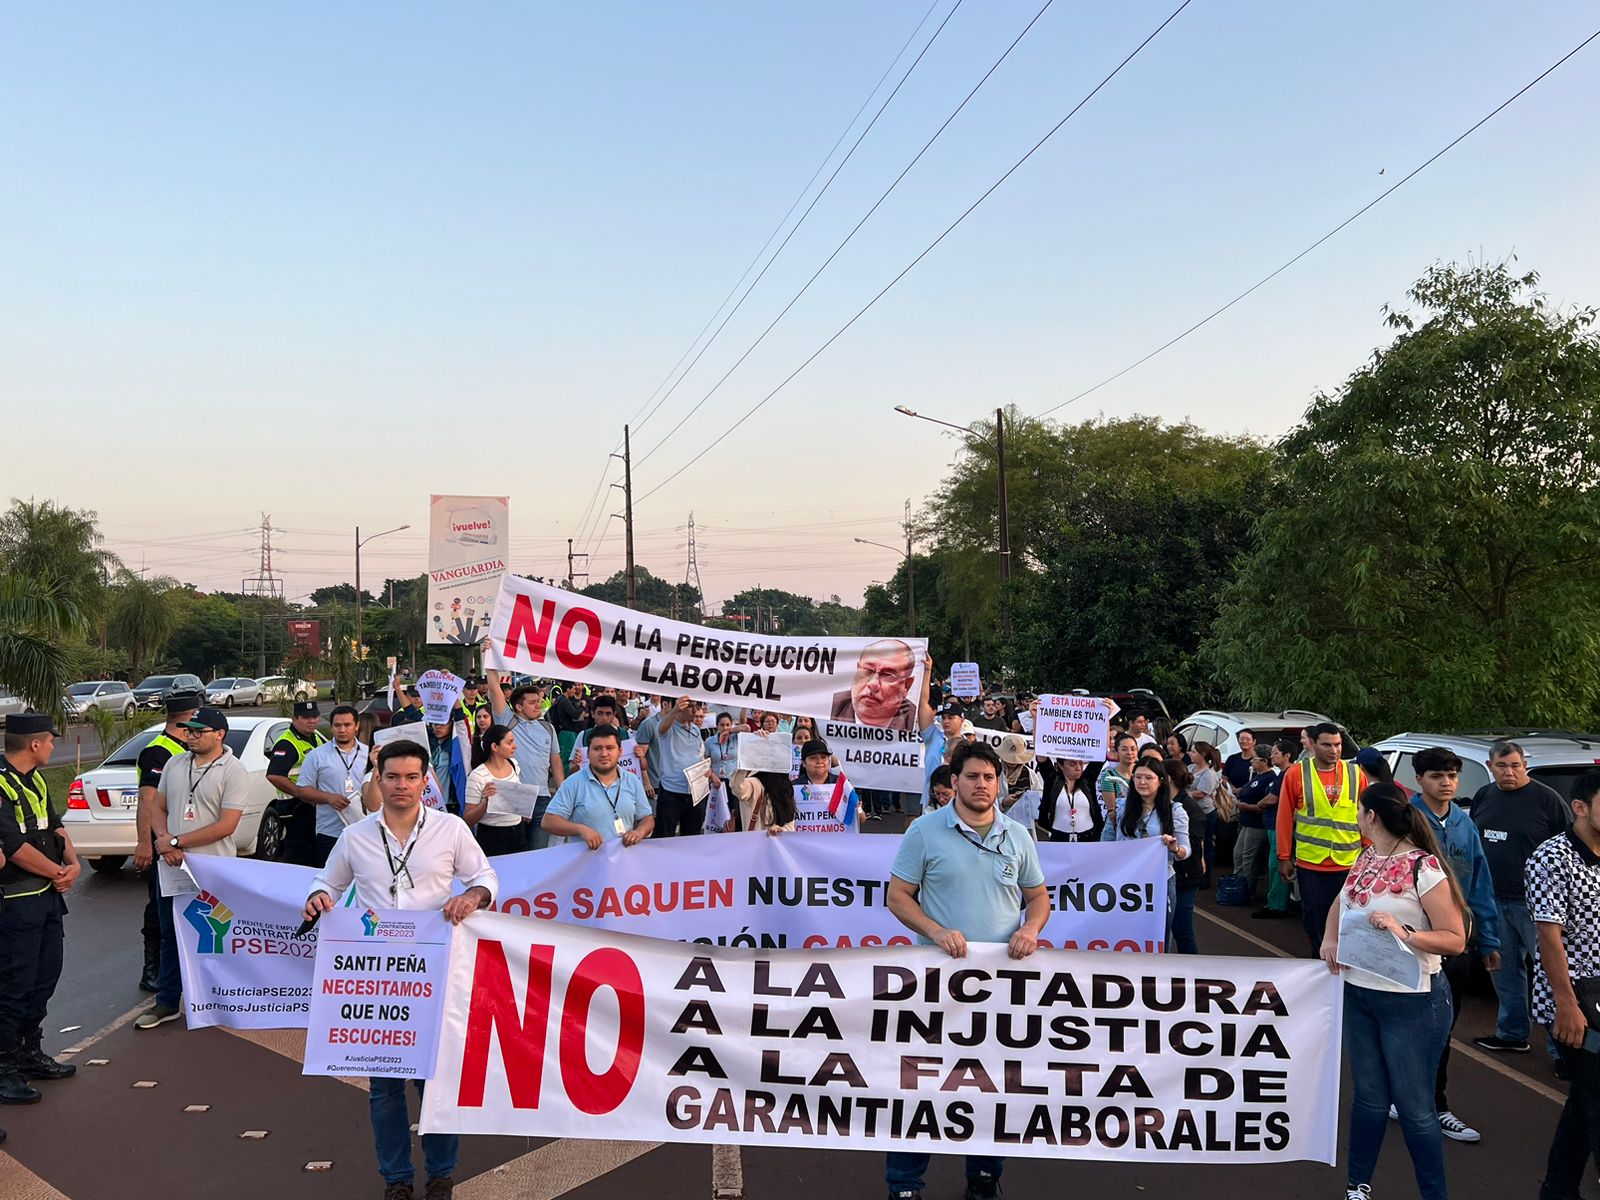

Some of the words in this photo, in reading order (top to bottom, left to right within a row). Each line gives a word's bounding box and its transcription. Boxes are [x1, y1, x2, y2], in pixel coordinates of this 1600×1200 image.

[431, 559, 505, 583] VANGUARDIA
[503, 593, 602, 670] NO
[611, 620, 626, 647] A
[634, 624, 662, 652] LA
[676, 633, 837, 675] PERSECUCIÓN
[641, 658, 782, 701] LABORAL
[1051, 697, 1069, 706] ESTA
[1071, 698, 1095, 708] LUCHA
[1040, 707, 1073, 718] TAMBIEN
[1073, 710, 1082, 719] ES
[1085, 711, 1105, 722] TUYA,
[826, 723, 894, 742] EXIGIMOS
[898, 729, 925, 743] RES
[1054, 721, 1089, 734] FUTURO
[1042, 734, 1100, 748] CONCURSANTE!!
[122, 796, 138, 804] AAF
[795, 811, 814, 821] ANTI
[796, 823, 845, 832] CESITAMOS
[488, 891, 559, 920] OS
[571, 878, 734, 919] SAQUEN
[748, 877, 889, 907] NUEST
[1046, 877, 1154, 913] EÑOS!
[237, 919, 262, 928] FRENTE
[232, 926, 318, 943] CONTRATADO
[377, 929, 415, 937] PSE2023
[333, 955, 381, 971] SANTI
[386, 954, 427, 973] PEÑA
[322, 979, 432, 998] NECESITAMOS
[673, 956, 726, 993] A
[753, 960, 846, 999] LA
[872, 964, 1290, 1017] DICTADURA
[341, 1004, 374, 1020] QUE
[378, 1005, 410, 1021] NOS
[457, 938, 646, 1115] NO
[670, 999, 723, 1035] A
[750, 1003, 844, 1040] LA
[870, 1008, 1291, 1060] INJUSTICIA
[328, 1028, 417, 1046] ESCUCHES!
[345, 1055, 402, 1063] #JusticiaPSE2023
[326, 1064, 417, 1074] #QueremosJusticiaPSE2023
[667, 1045, 729, 1079] A
[760, 1049, 869, 1088] LA
[900, 1055, 1154, 1098] FALTA
[1184, 1067, 1288, 1103] DE
[665, 1085, 975, 1142] GARANTIAS
[993, 1102, 1291, 1152] LABORALES
